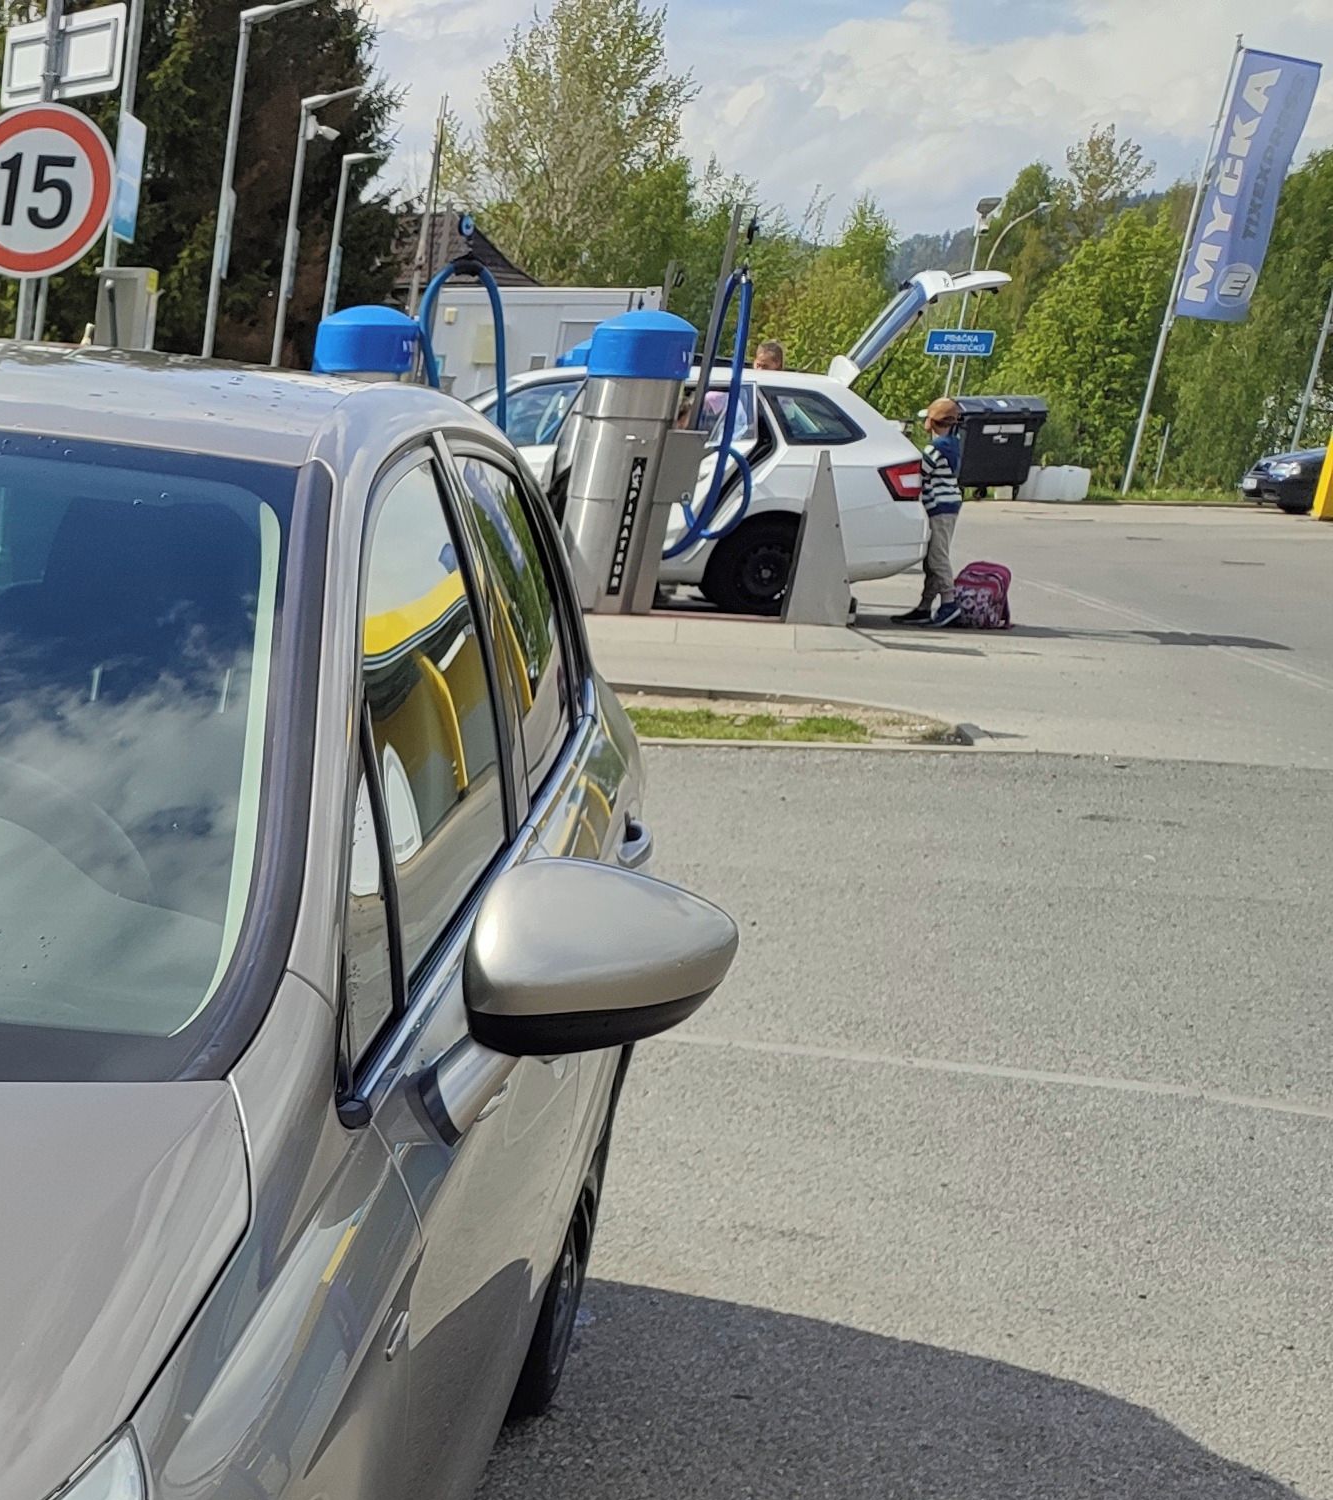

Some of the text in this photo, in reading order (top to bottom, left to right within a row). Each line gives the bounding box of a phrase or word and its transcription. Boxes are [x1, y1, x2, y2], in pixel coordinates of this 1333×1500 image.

[0, 152, 76, 229] 15
[1184, 68, 1282, 302] MYČKA
[1242, 73, 1307, 241] TIXEXPR
[611, 465, 642, 587] ASPIRATEUR
